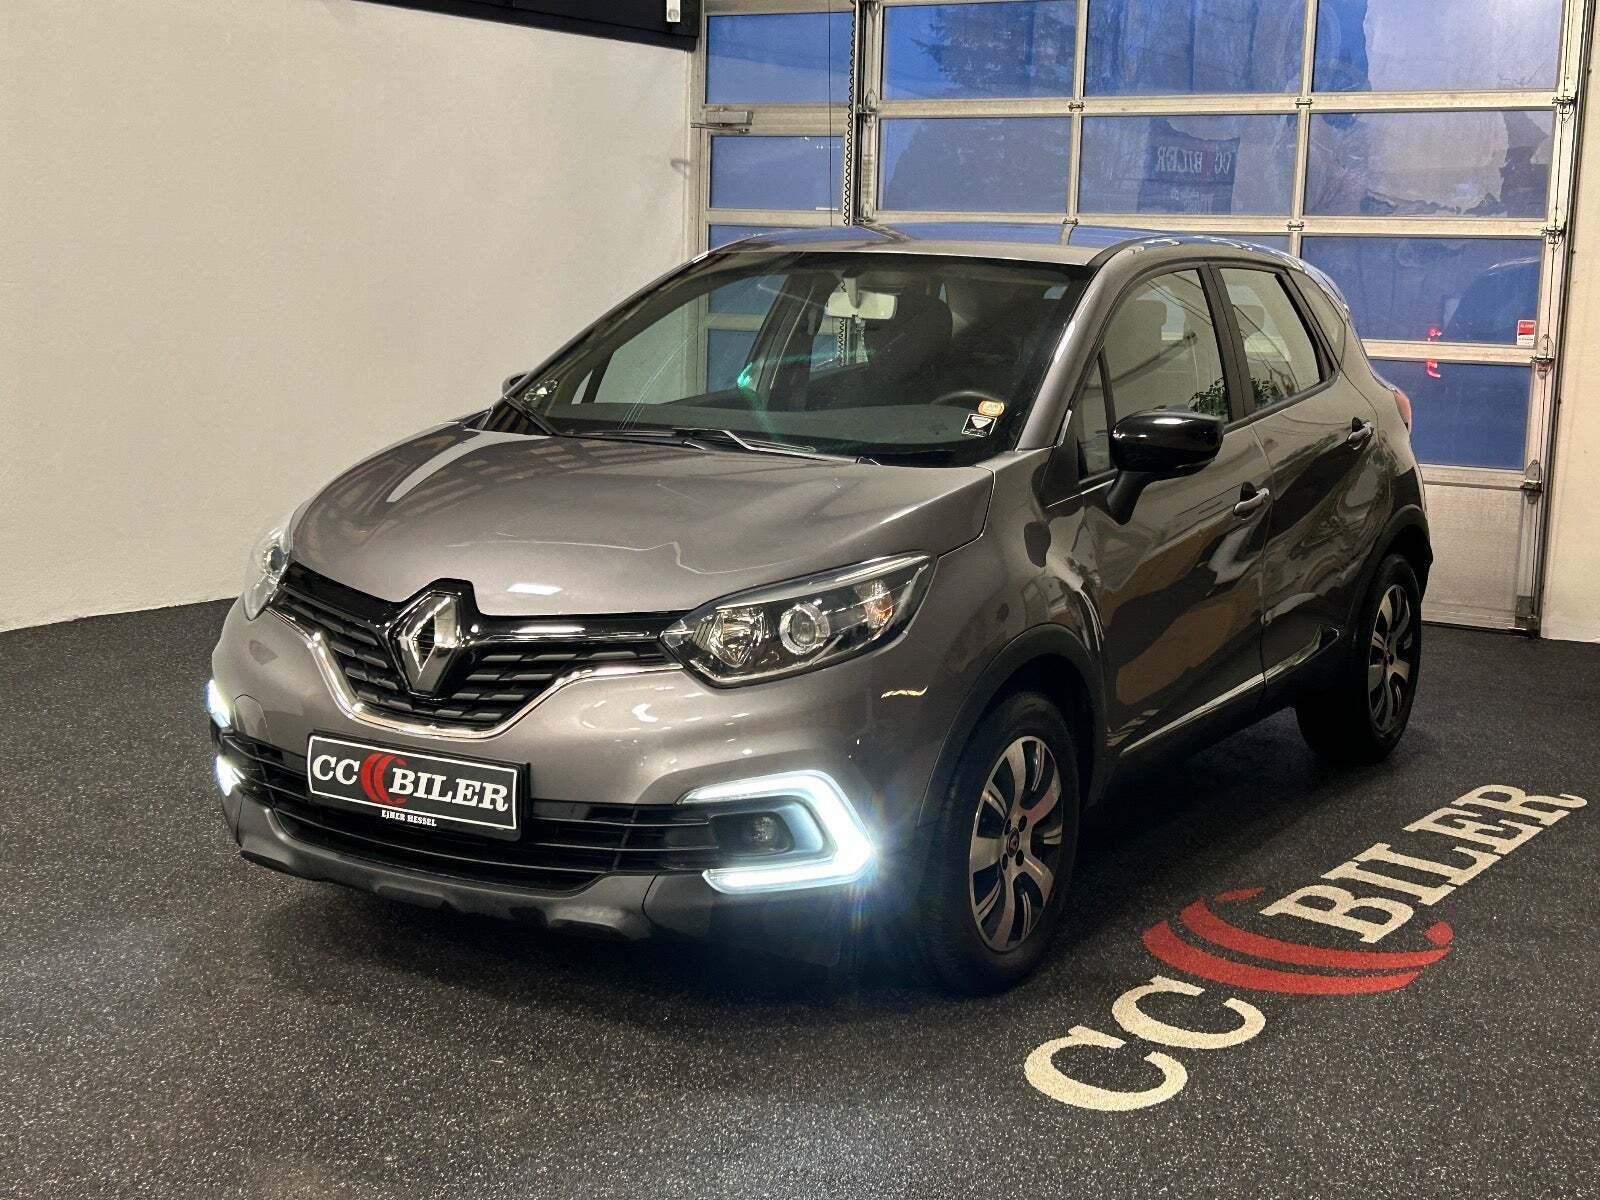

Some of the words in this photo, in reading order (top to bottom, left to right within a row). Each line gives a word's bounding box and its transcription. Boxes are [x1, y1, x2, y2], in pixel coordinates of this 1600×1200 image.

[312, 754, 360, 785] CC
[388, 768, 509, 812] BILER
[407, 814, 437, 827] HESSEL
[1024, 976, 1266, 1112] CC
[1259, 784, 1588, 944] BILER
